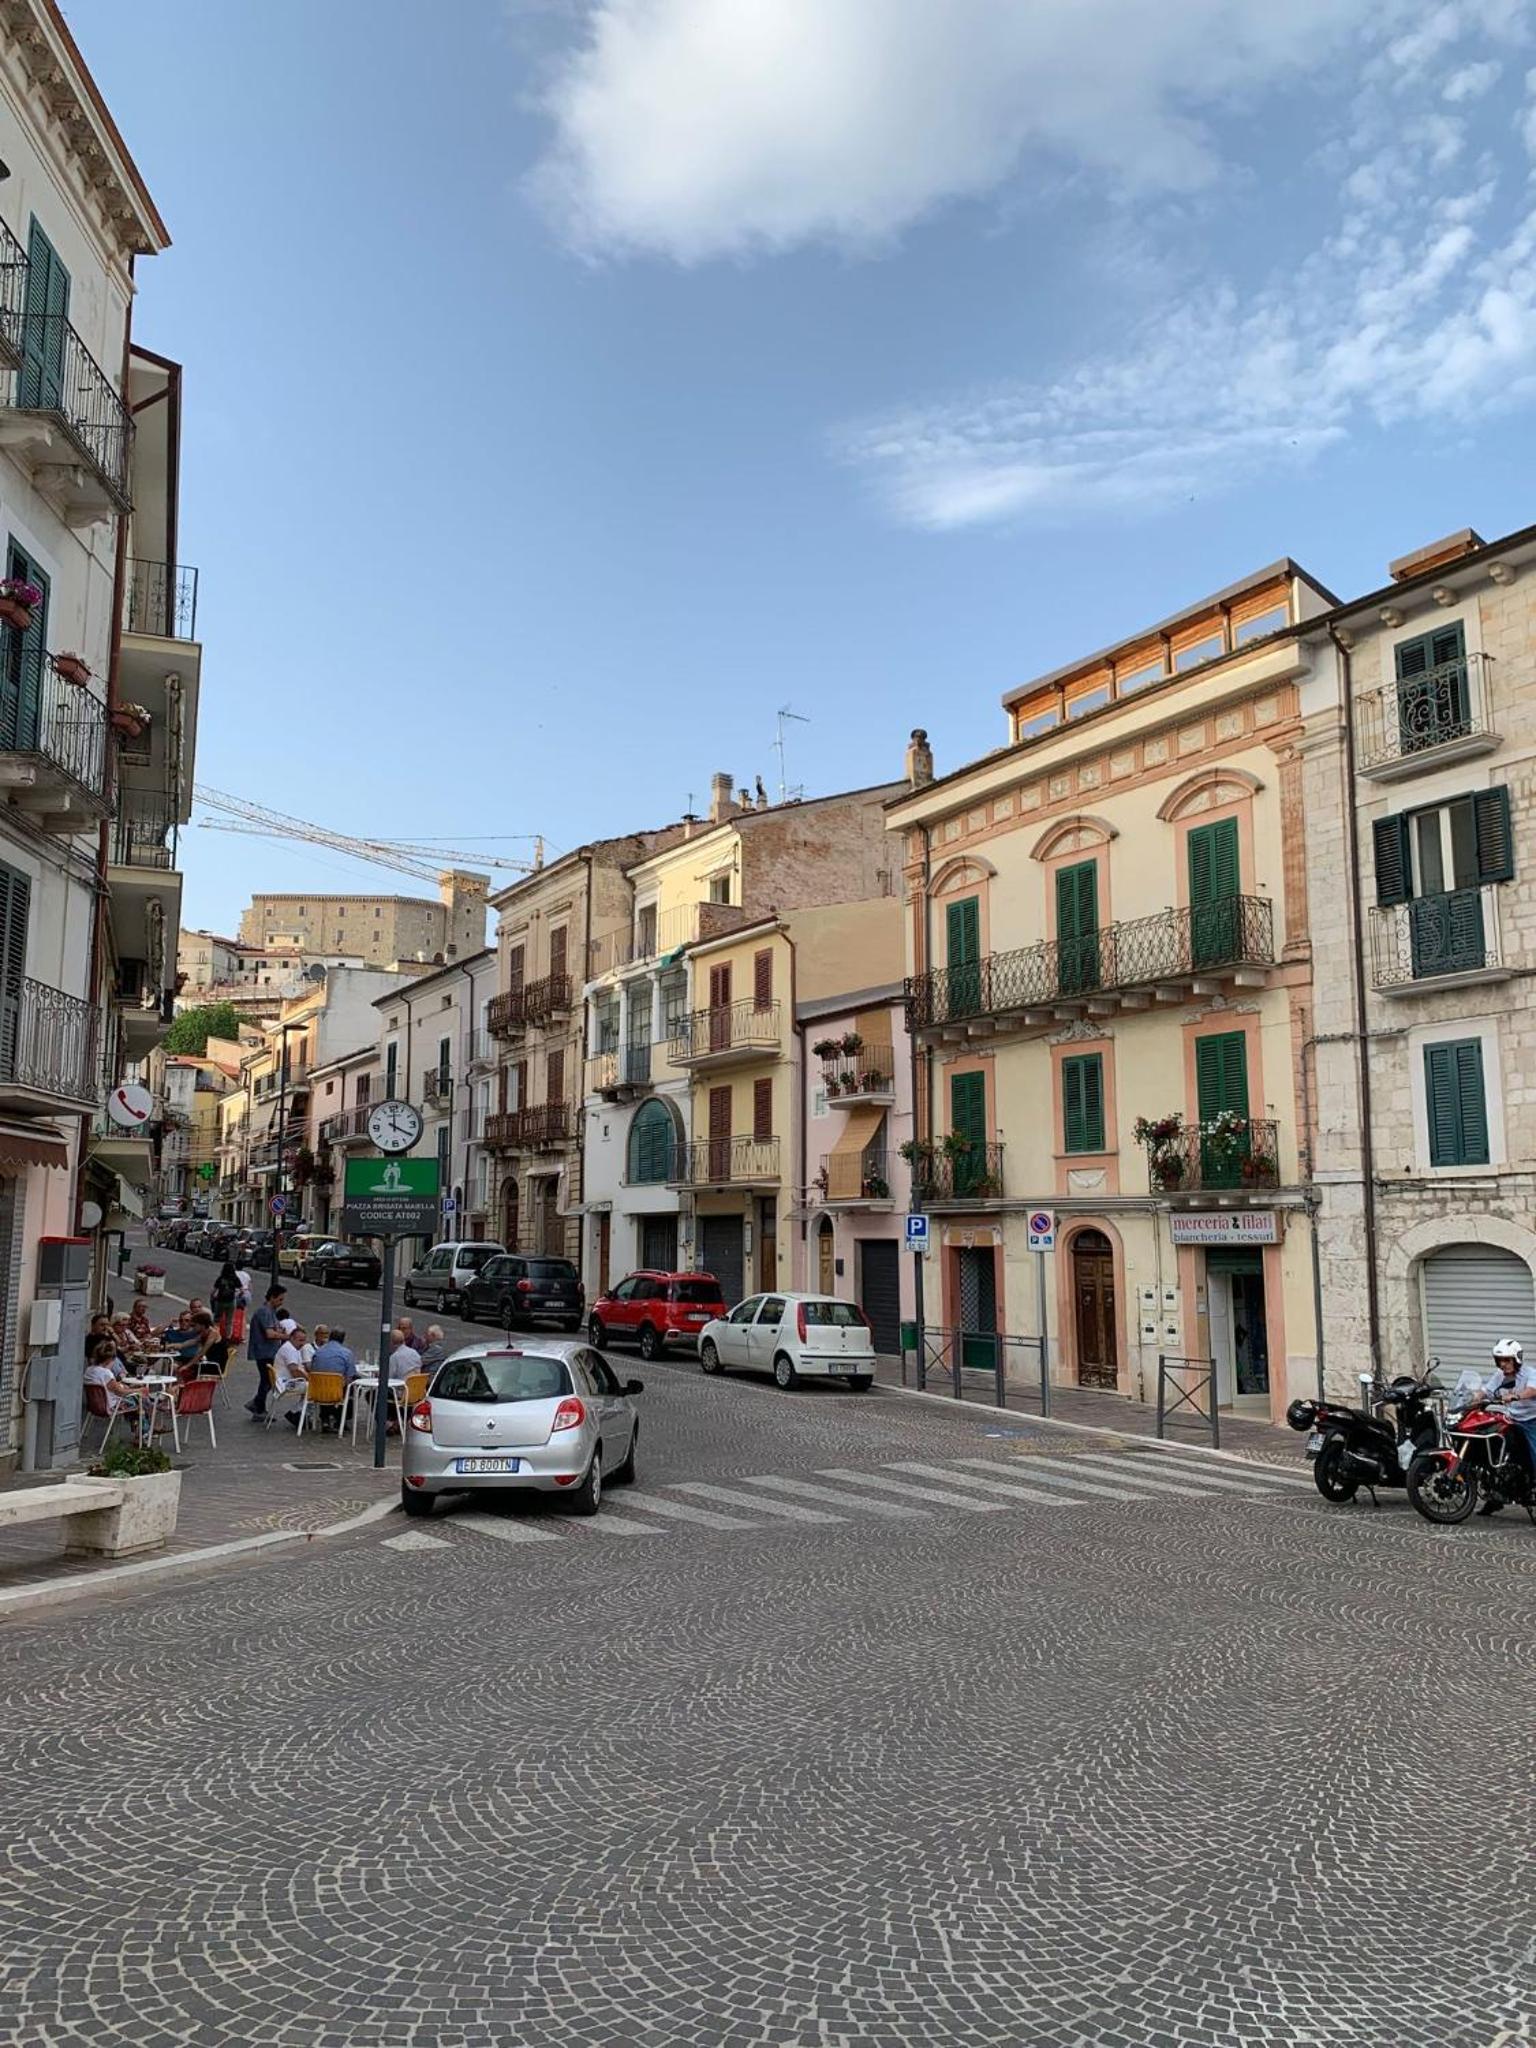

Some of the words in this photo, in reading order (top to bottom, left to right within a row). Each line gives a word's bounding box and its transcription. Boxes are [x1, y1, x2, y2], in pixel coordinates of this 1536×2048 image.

[373, 1124, 380, 1132] 9
[409, 1120, 416, 1128] 3
[360, 1212, 394, 1220] CODICE
[1173, 1215, 1230, 1230] merceria
[1242, 1214, 1272, 1230] filati
[911, 1219, 922, 1234] P
